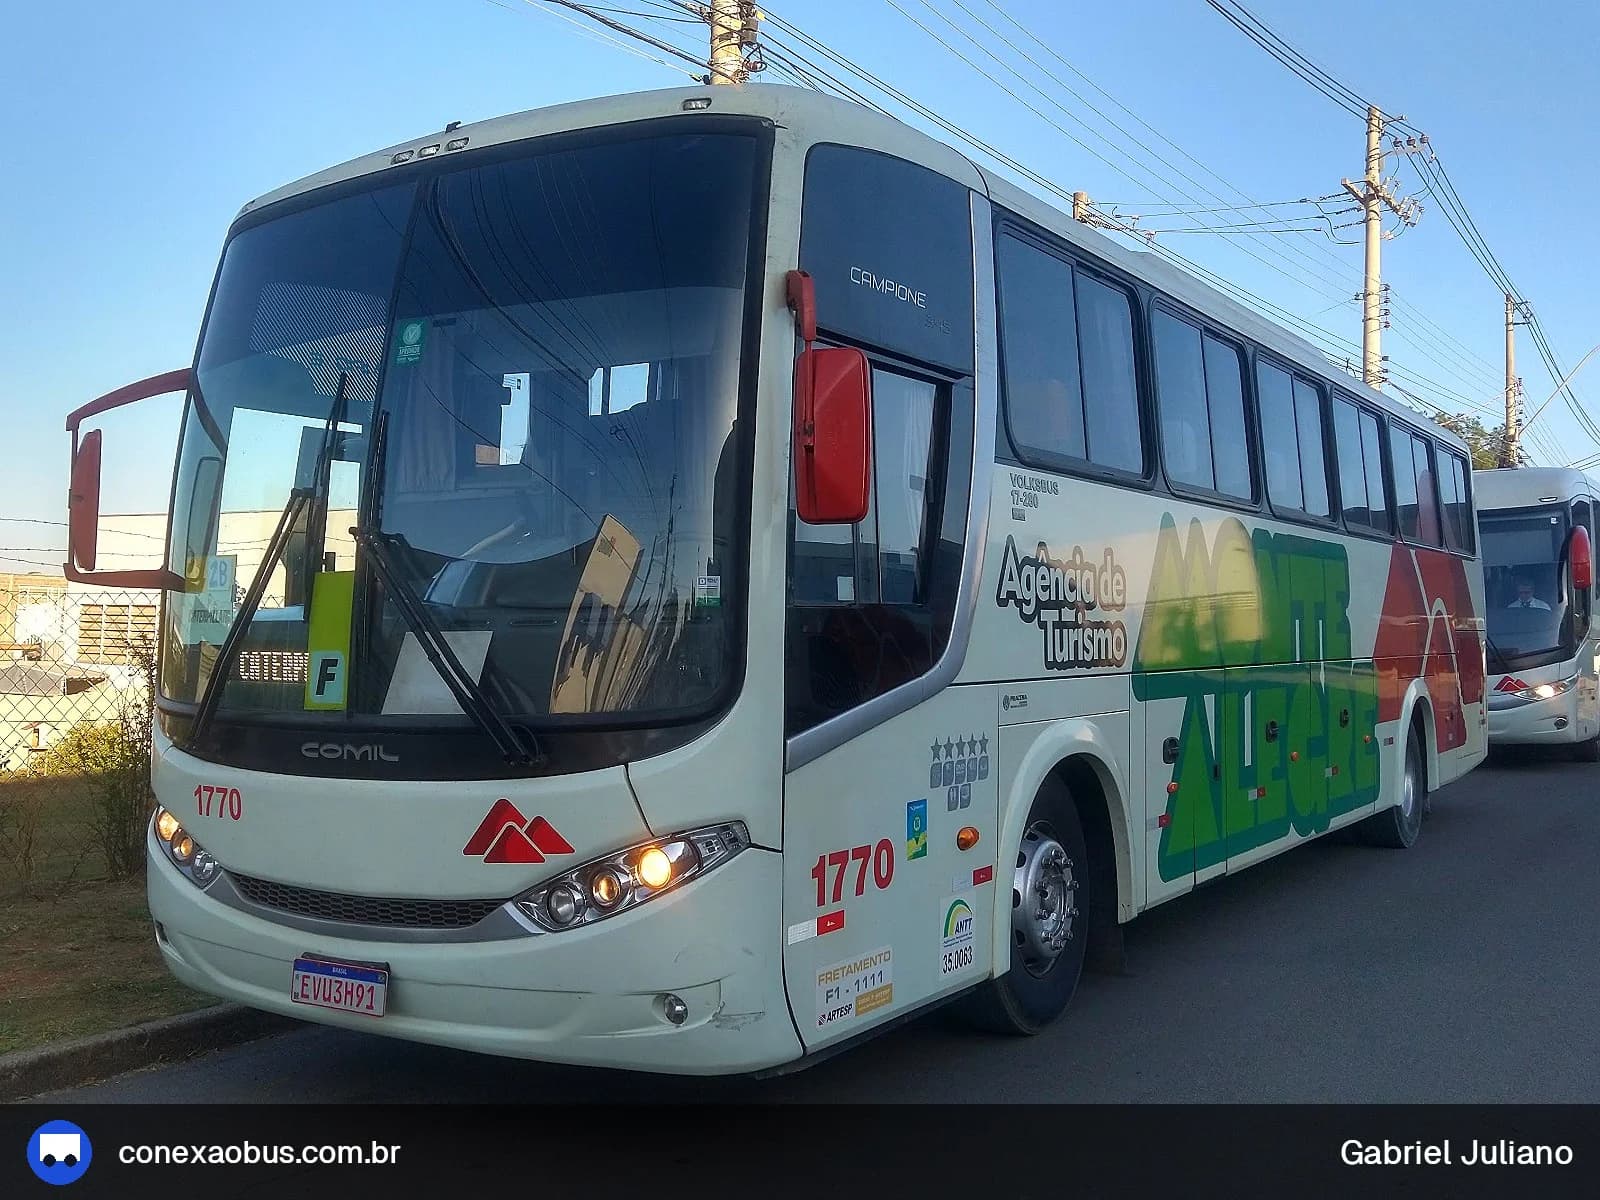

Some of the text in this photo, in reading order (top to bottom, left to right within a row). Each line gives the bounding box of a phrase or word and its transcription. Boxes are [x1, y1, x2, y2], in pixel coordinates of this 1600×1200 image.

[850, 266, 926, 309] CAMPIONE
[1009, 472, 1059, 496] VOLKSBUS
[998, 537, 1126, 620] Agência de
[1132, 511, 1353, 700] MONTE
[1039, 608, 1127, 668] Turismo
[315, 658, 339, 696] F
[300, 742, 400, 763] COMIL
[1157, 658, 1381, 883] ALEGRE
[193, 784, 243, 821] 1770
[811, 838, 896, 908] 1770
[955, 917, 973, 935] ANTT
[817, 950, 892, 986] FRETAMENTO
[942, 945, 974, 974] 35.0063
[301, 974, 375, 1011] EVU3H91
[825, 986, 840, 1004] F1
[854, 969, 883, 993] 1111
[826, 1003, 853, 1023] ARTESP
